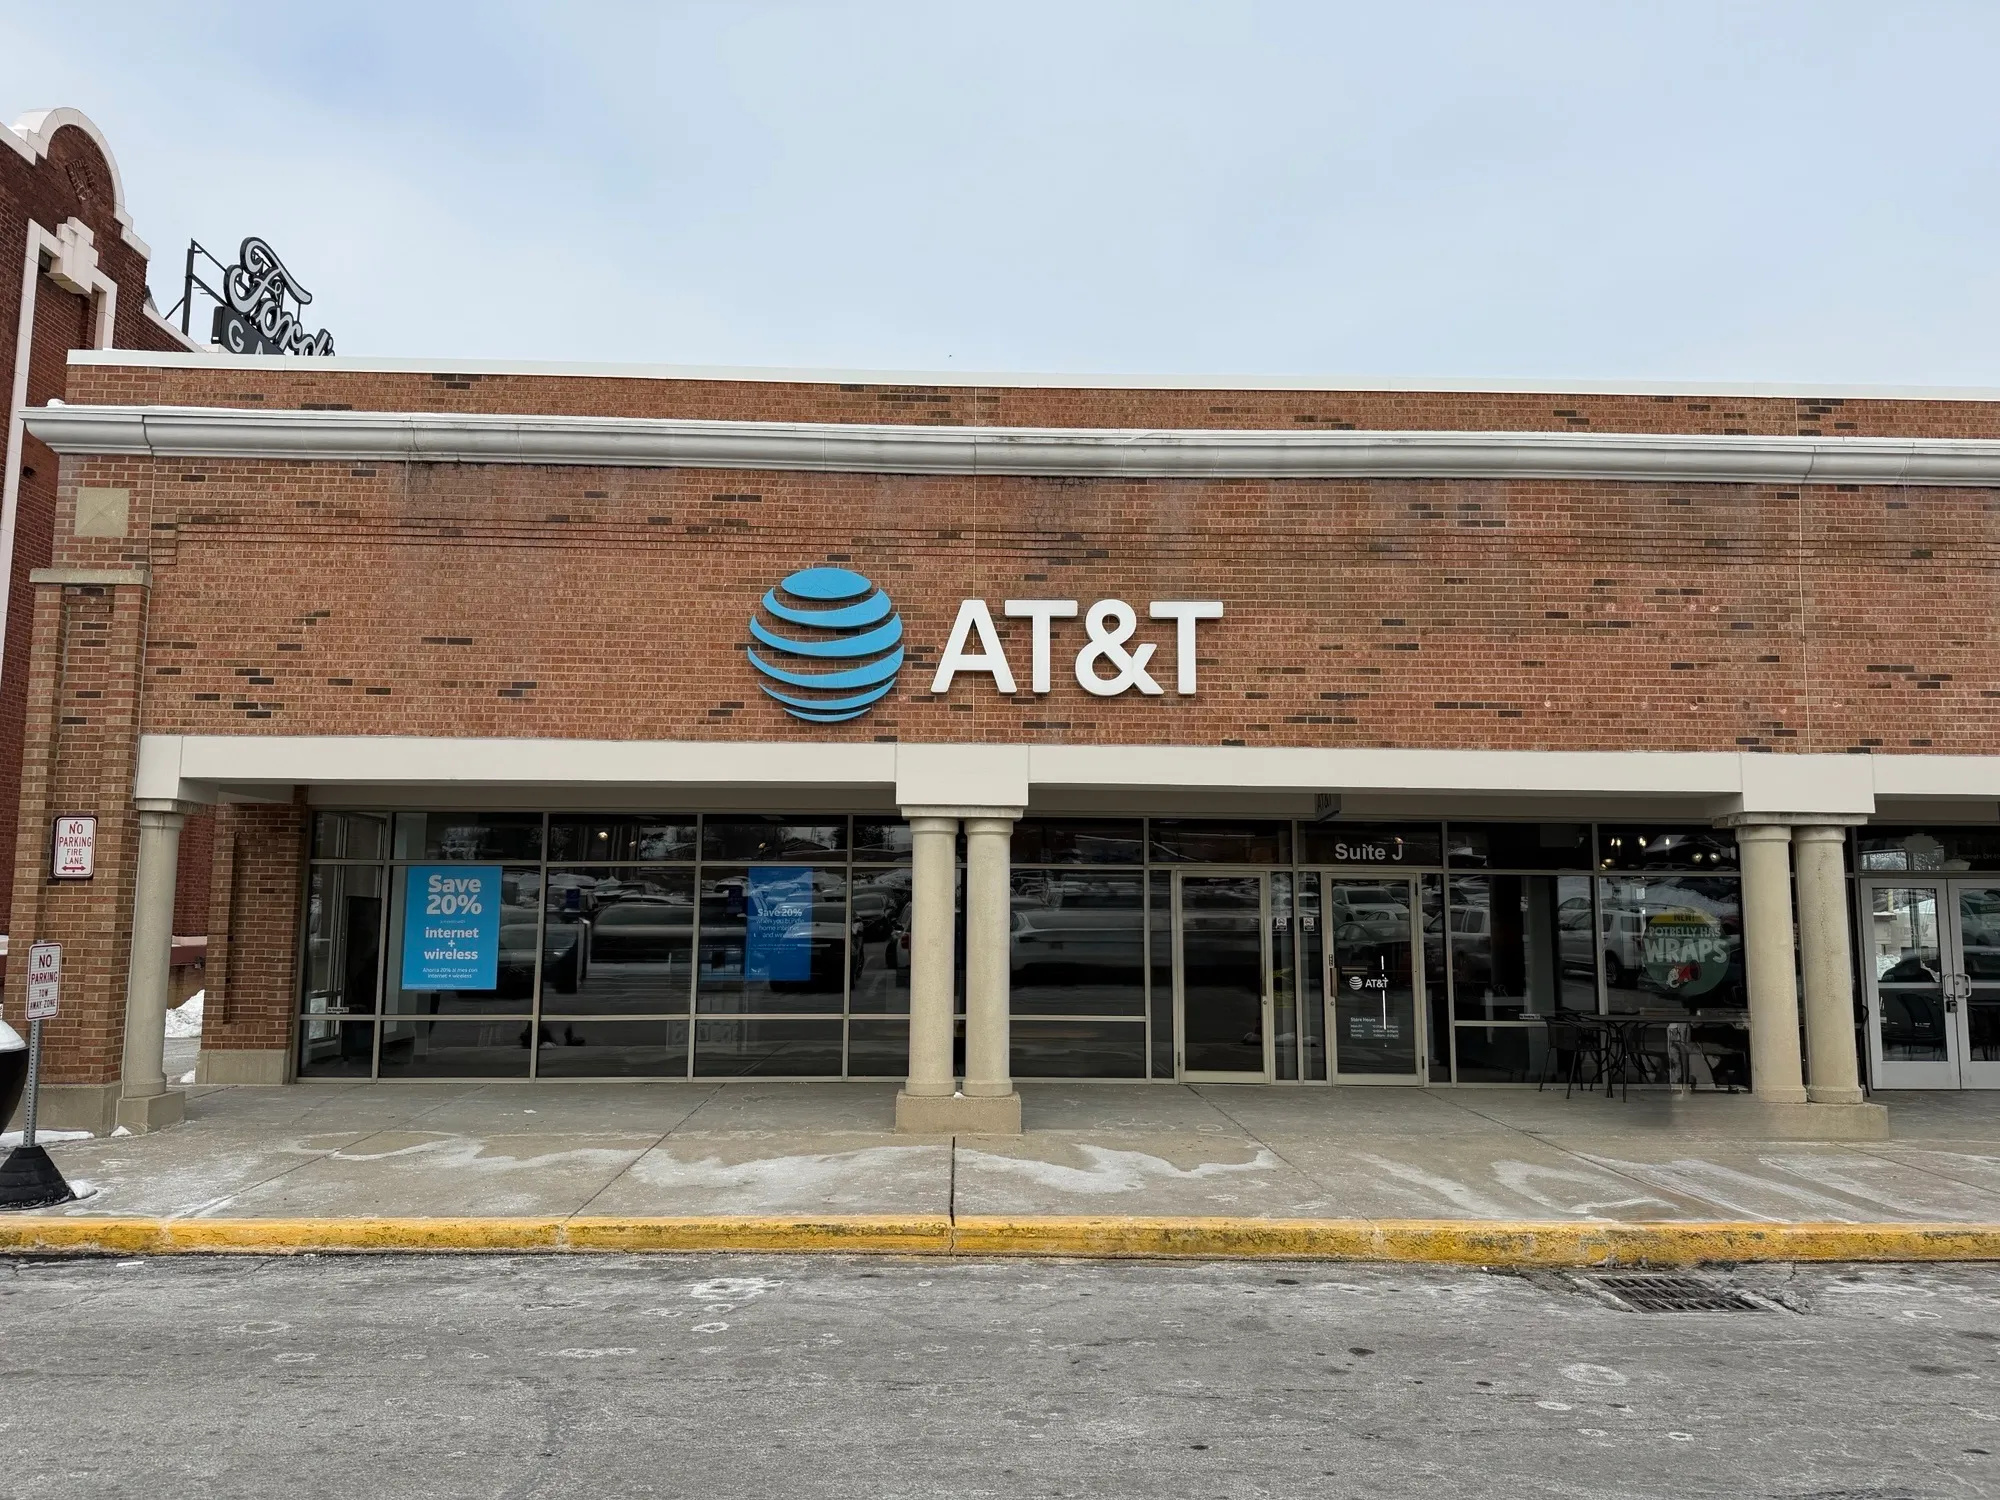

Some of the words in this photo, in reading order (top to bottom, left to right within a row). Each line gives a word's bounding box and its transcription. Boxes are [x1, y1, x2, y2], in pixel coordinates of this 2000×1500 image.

[930, 599, 1224, 697] AT&T
[69, 824, 84, 835] NO
[59, 836, 92, 848] PARKING
[66, 848, 83, 856] FIRE
[1335, 843, 1386, 861] Suite
[1391, 844, 1403, 862] J
[65, 857, 84, 865] LANE
[428, 874, 481, 893] Save
[426, 894, 482, 915] 20%
[757, 908, 780, 917] Save
[781, 908, 803, 917] 20%
[425, 927, 479, 938] internet
[1648, 926, 1697, 937] POTBELLY
[1700, 926, 1721, 938] HAS
[424, 948, 478, 960] wireless
[1643, 938, 1727, 963] WRAPS
[38, 954, 52, 968] NO
[31, 971, 58, 985] PARKING
[1365, 979, 1389, 988] AT&T
[38, 989, 48, 997] TOW
[30, 1001, 43, 1010] AWAY
[44, 999, 56, 1008] ZONE
